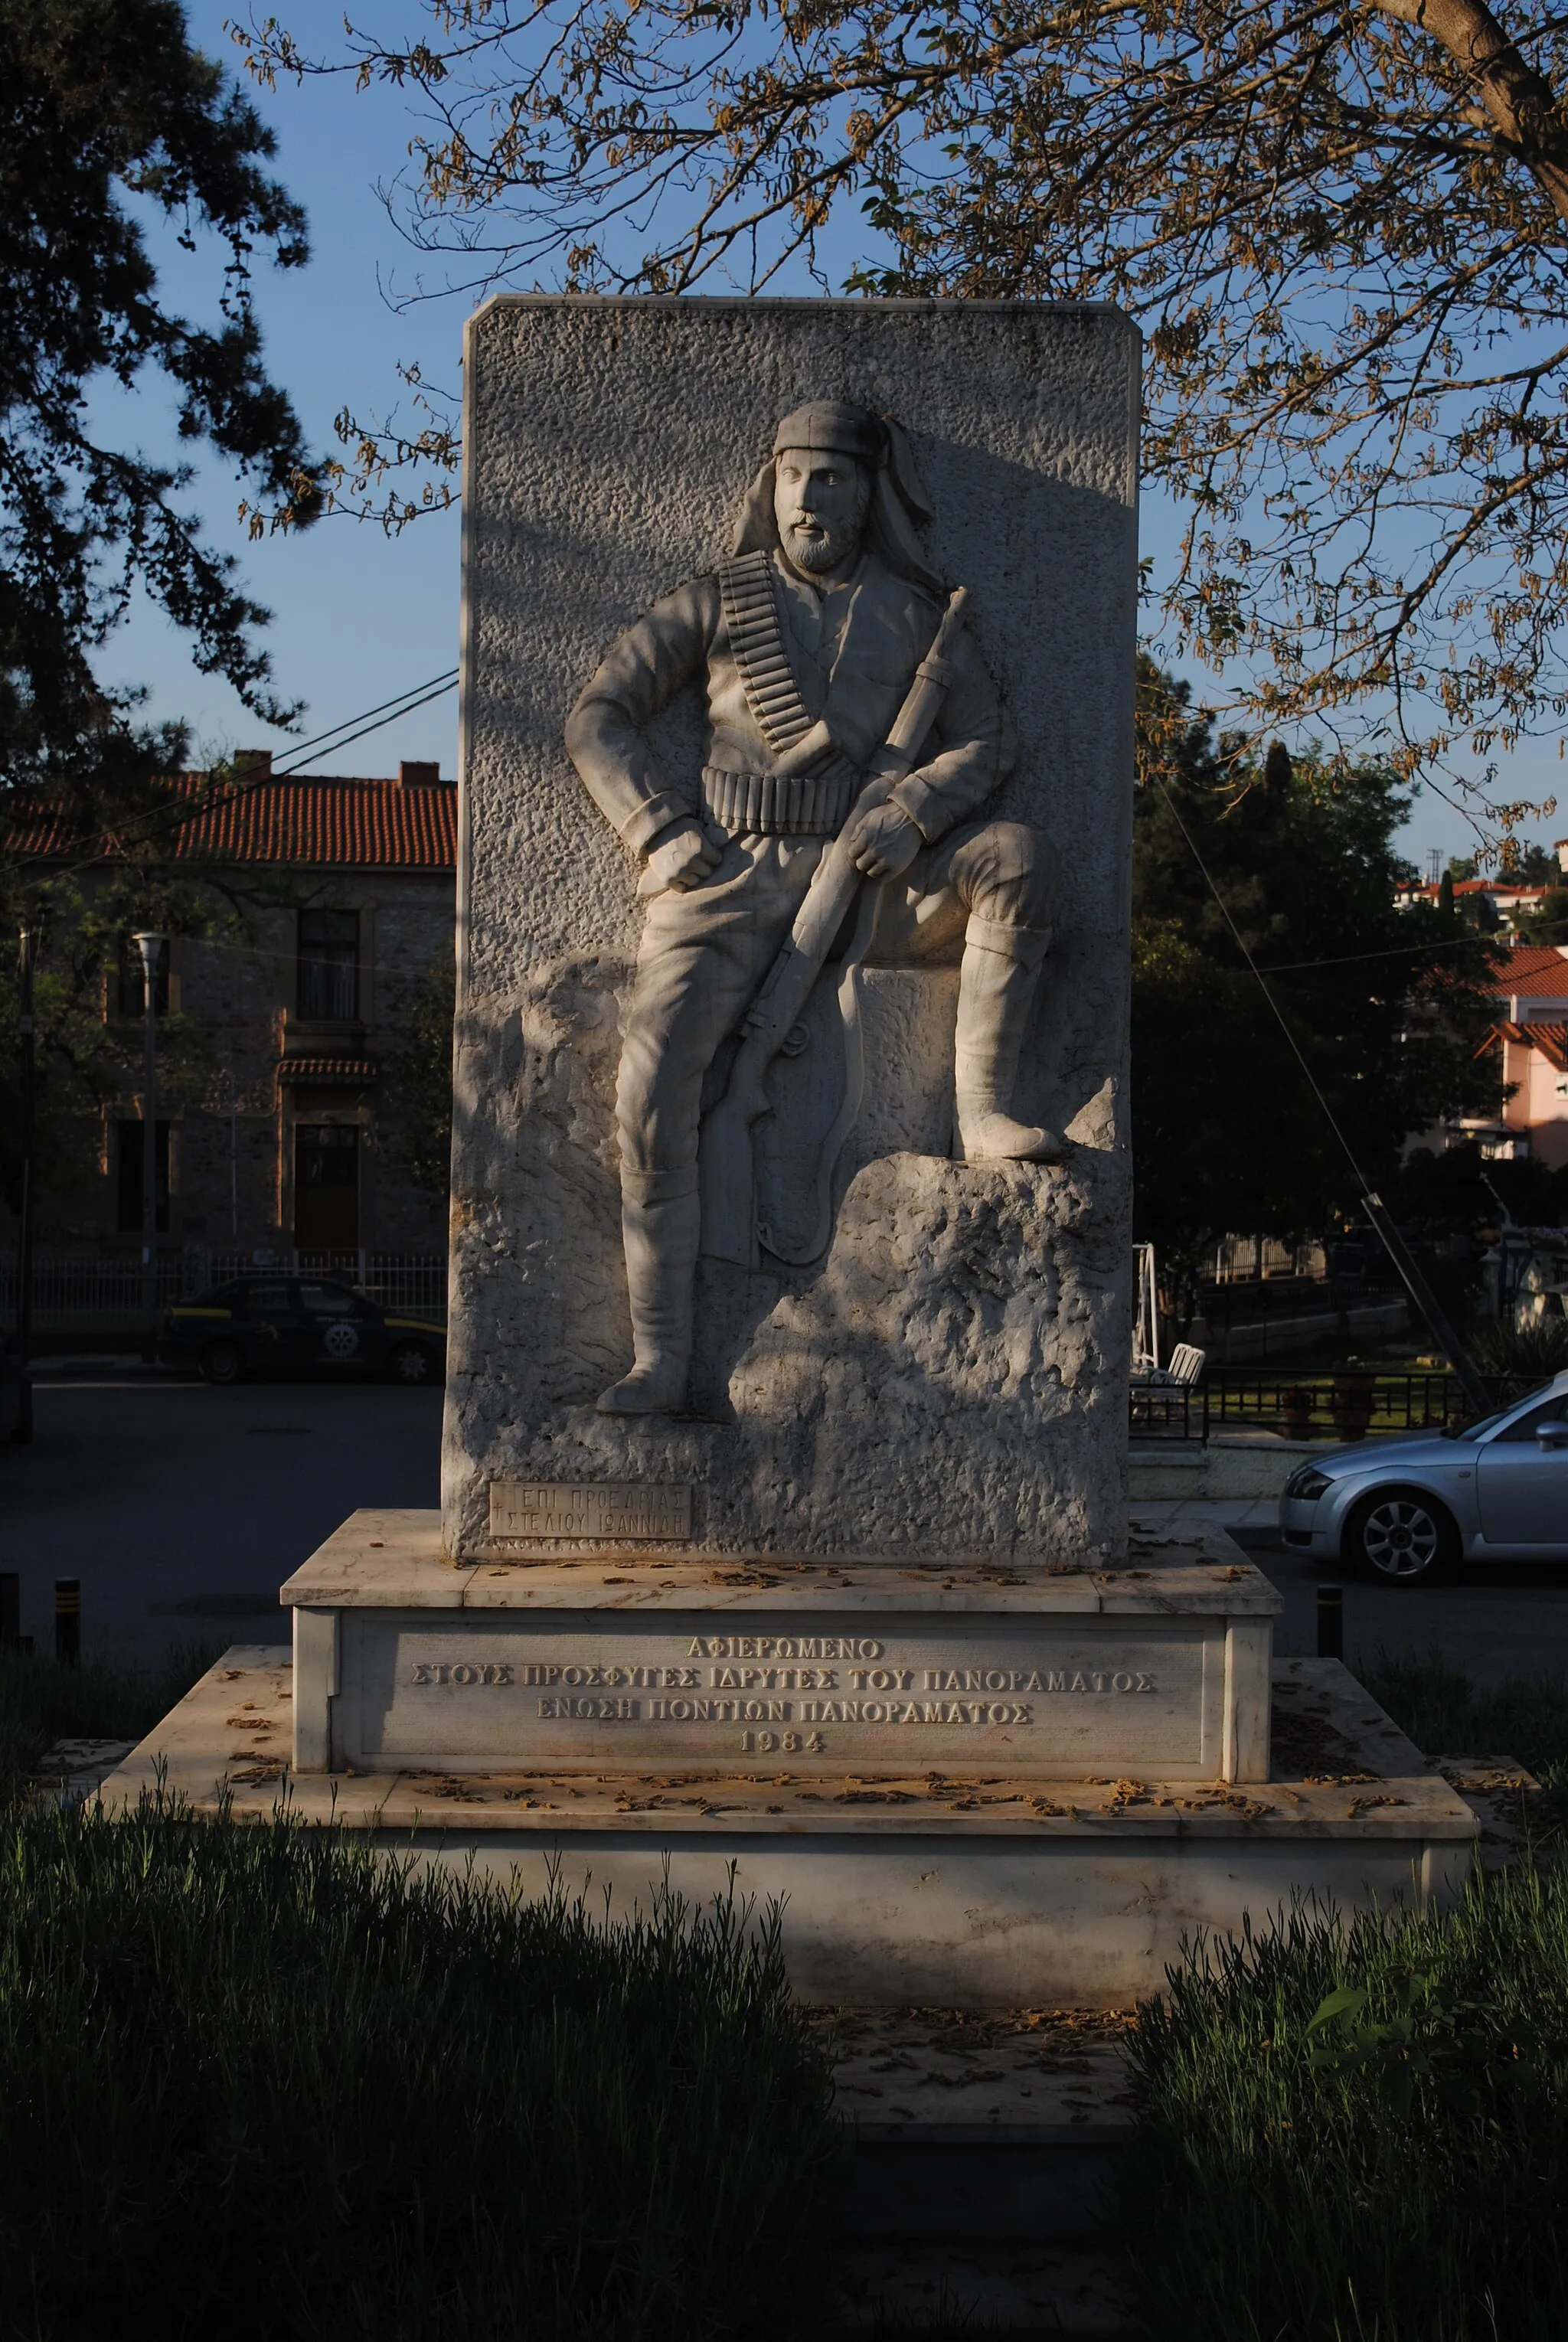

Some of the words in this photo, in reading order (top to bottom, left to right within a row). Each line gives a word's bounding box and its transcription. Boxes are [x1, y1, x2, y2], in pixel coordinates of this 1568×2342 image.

[523, 1489, 557, 1507] ΕΠΙ
[571, 1490, 685, 1510] ΠΡΟΕΔΡΙΑΣ
[508, 1511, 585, 1531] ΣΤΕΛΙΟΥ
[599, 1513, 684, 1533] ΙΩΑΝΝΙΔΗ
[688, 1637, 880, 1659] ΑΦΙΕΡΩΜΕΝΟ
[411, 1662, 510, 1685] ΣΤΟΥΣ
[524, 1664, 697, 1687] ΠΡΟΣΦΥΓΕΣ
[710, 1667, 834, 1689] ΙΔΡΥΤΕΣ
[848, 1669, 908, 1690] ΤΟΥ
[923, 1669, 1152, 1693] ΠΑΝΟΡΑΜΑΤΟΣ
[537, 1697, 635, 1719] ΕΝΩΣΗ
[648, 1698, 785, 1721] ΠΟΝΤΙΩΝ
[800, 1700, 1030, 1724] ΠΑΝΟΡΑΜΑΤΟΣ
[740, 1730, 824, 1752] 1984
